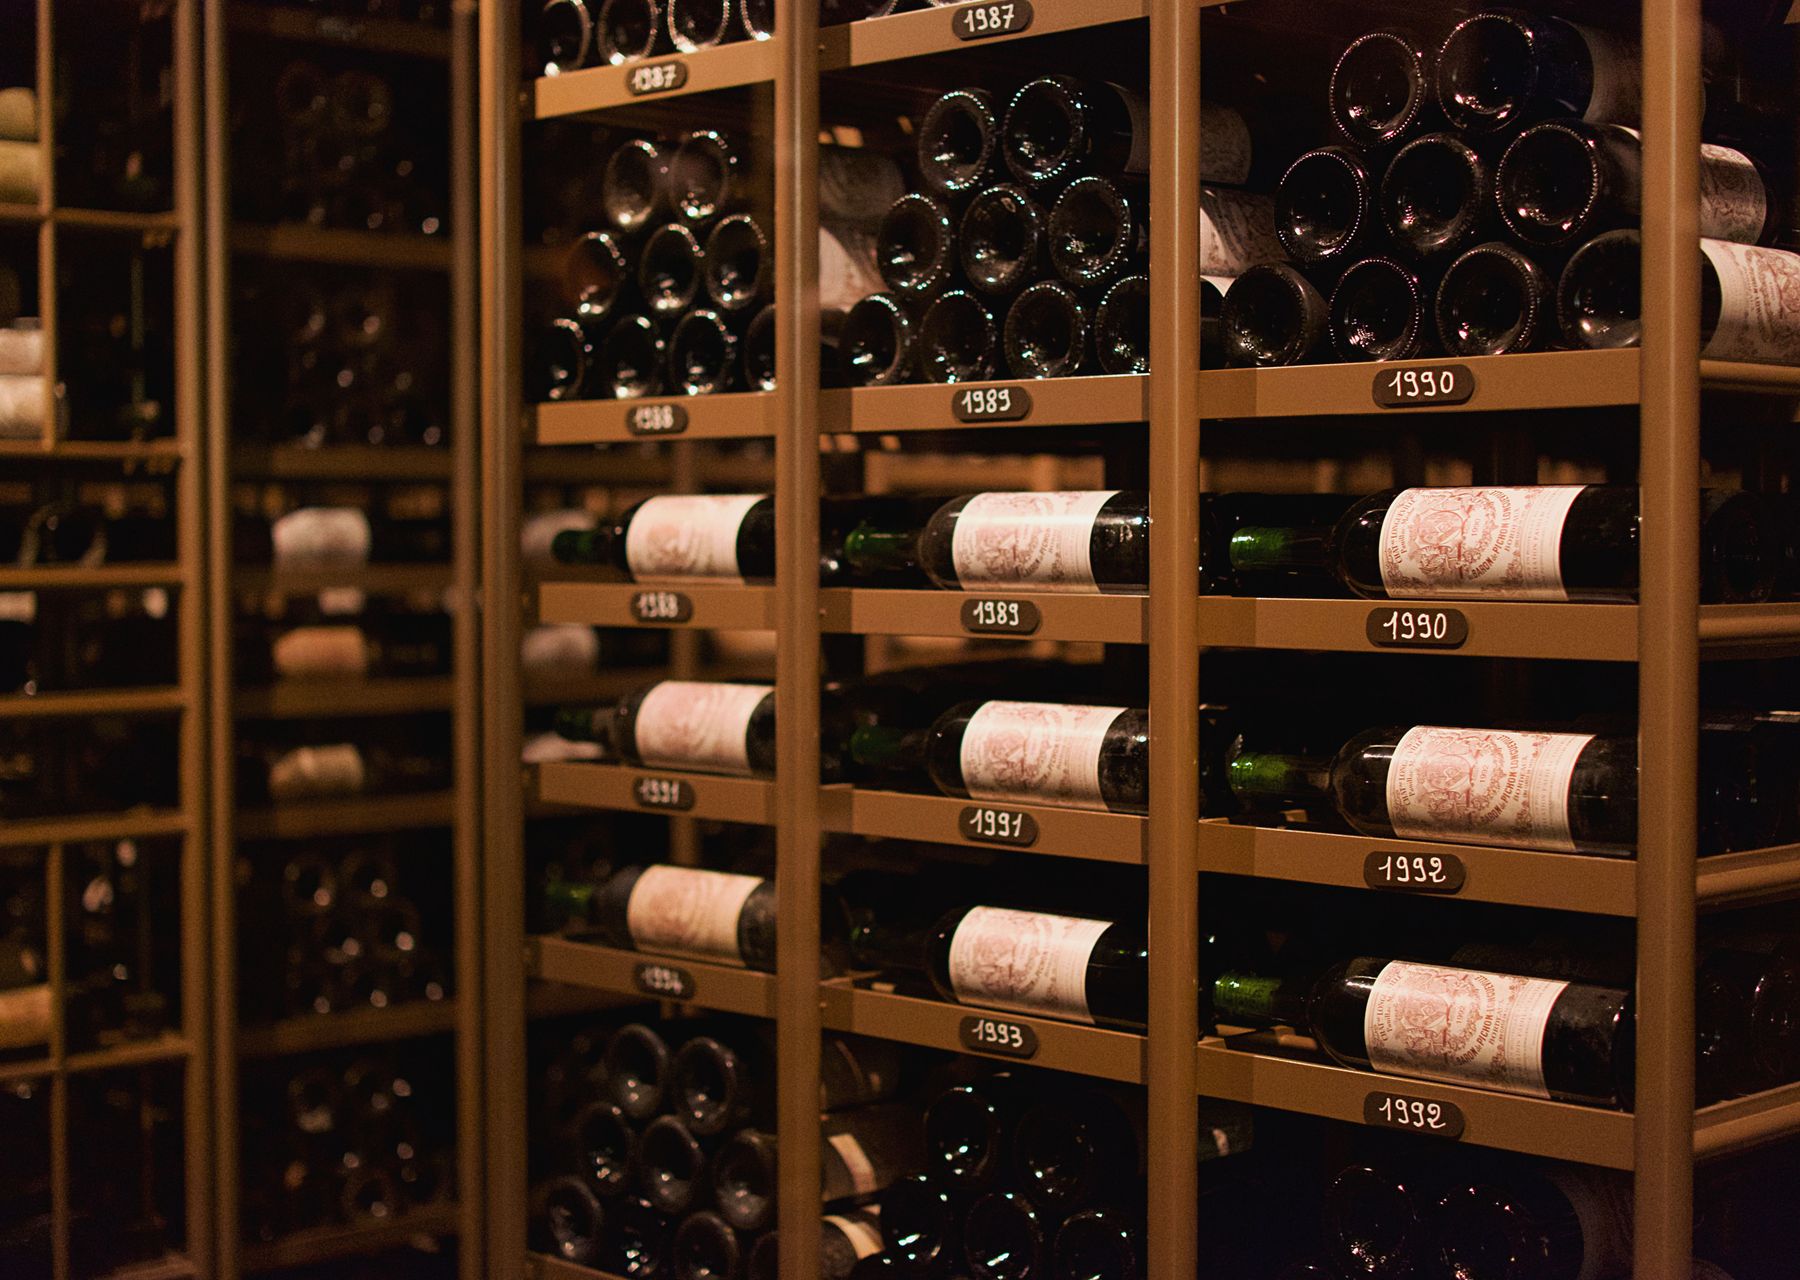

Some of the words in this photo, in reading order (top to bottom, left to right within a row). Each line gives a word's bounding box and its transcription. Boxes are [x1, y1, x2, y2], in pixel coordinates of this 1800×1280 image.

[964, 4, 1014, 32] 1987
[1388, 371, 1454, 397] 1990
[961, 388, 1011, 413] 1989
[1492, 523, 1509, 555] PICHON
[973, 601, 1019, 626] 1989
[1383, 611, 1447, 640] 1990
[1500, 772, 1517, 804] PICHON
[969, 809, 1022, 837] 1991
[1379, 856, 1446, 883] 1992
[972, 1019, 1023, 1048] 1993
[1476, 1014, 1494, 1046] PICHON
[1379, 1098, 1446, 1128] 1992
